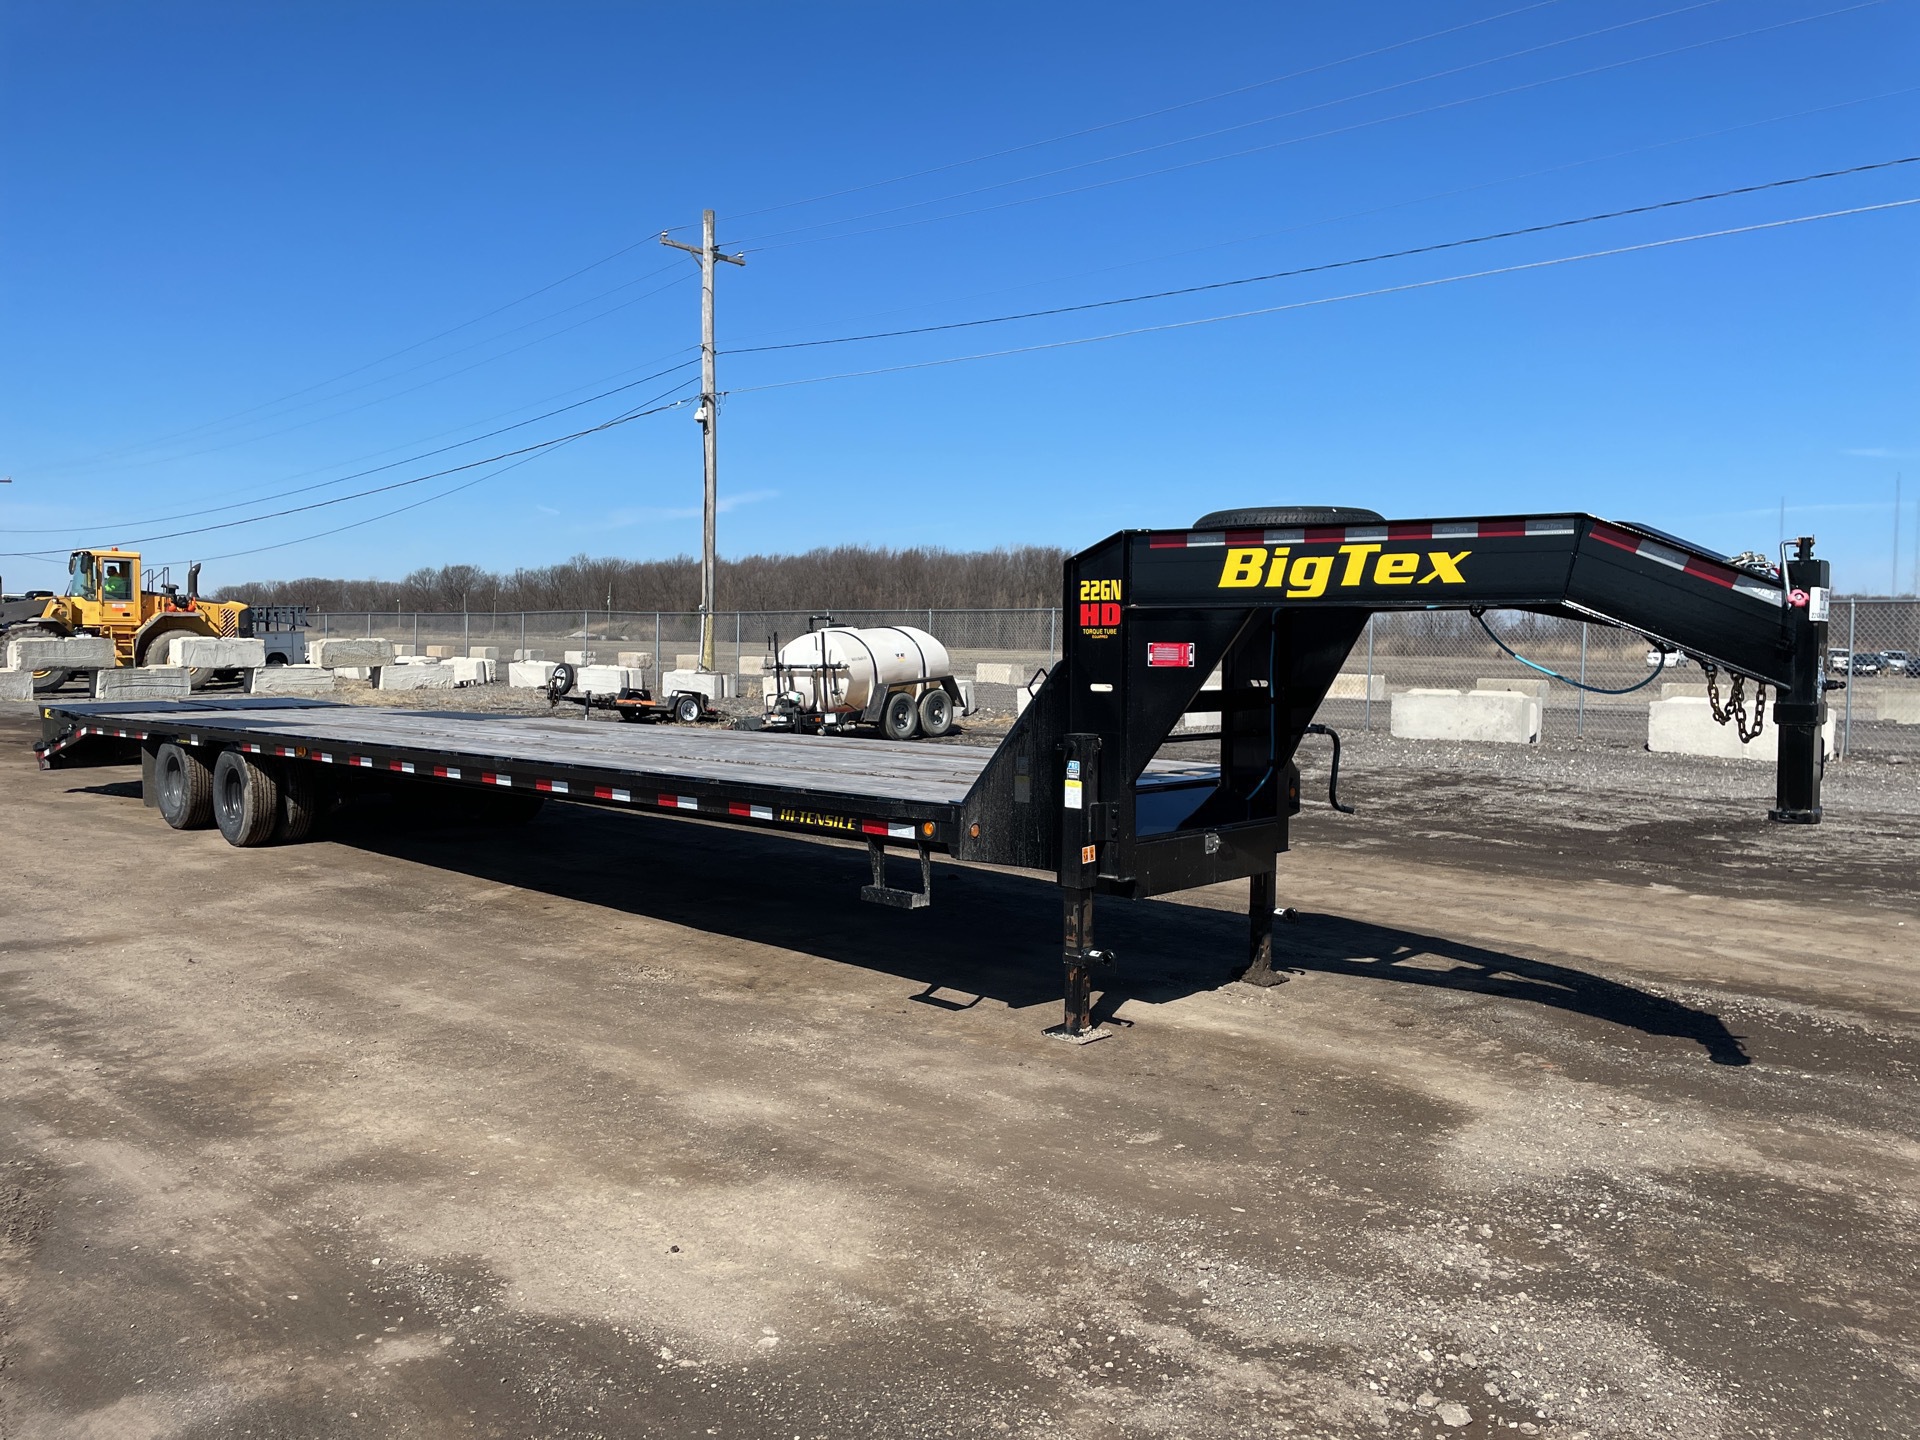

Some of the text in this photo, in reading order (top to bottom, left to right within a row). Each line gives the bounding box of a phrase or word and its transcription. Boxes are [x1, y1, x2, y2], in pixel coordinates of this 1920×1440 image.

[1218, 544, 1472, 598] BigTex
[1080, 580, 1121, 600] 22GN
[1080, 603, 1120, 626] HD
[780, 808, 856, 830] HI-TENSILE
